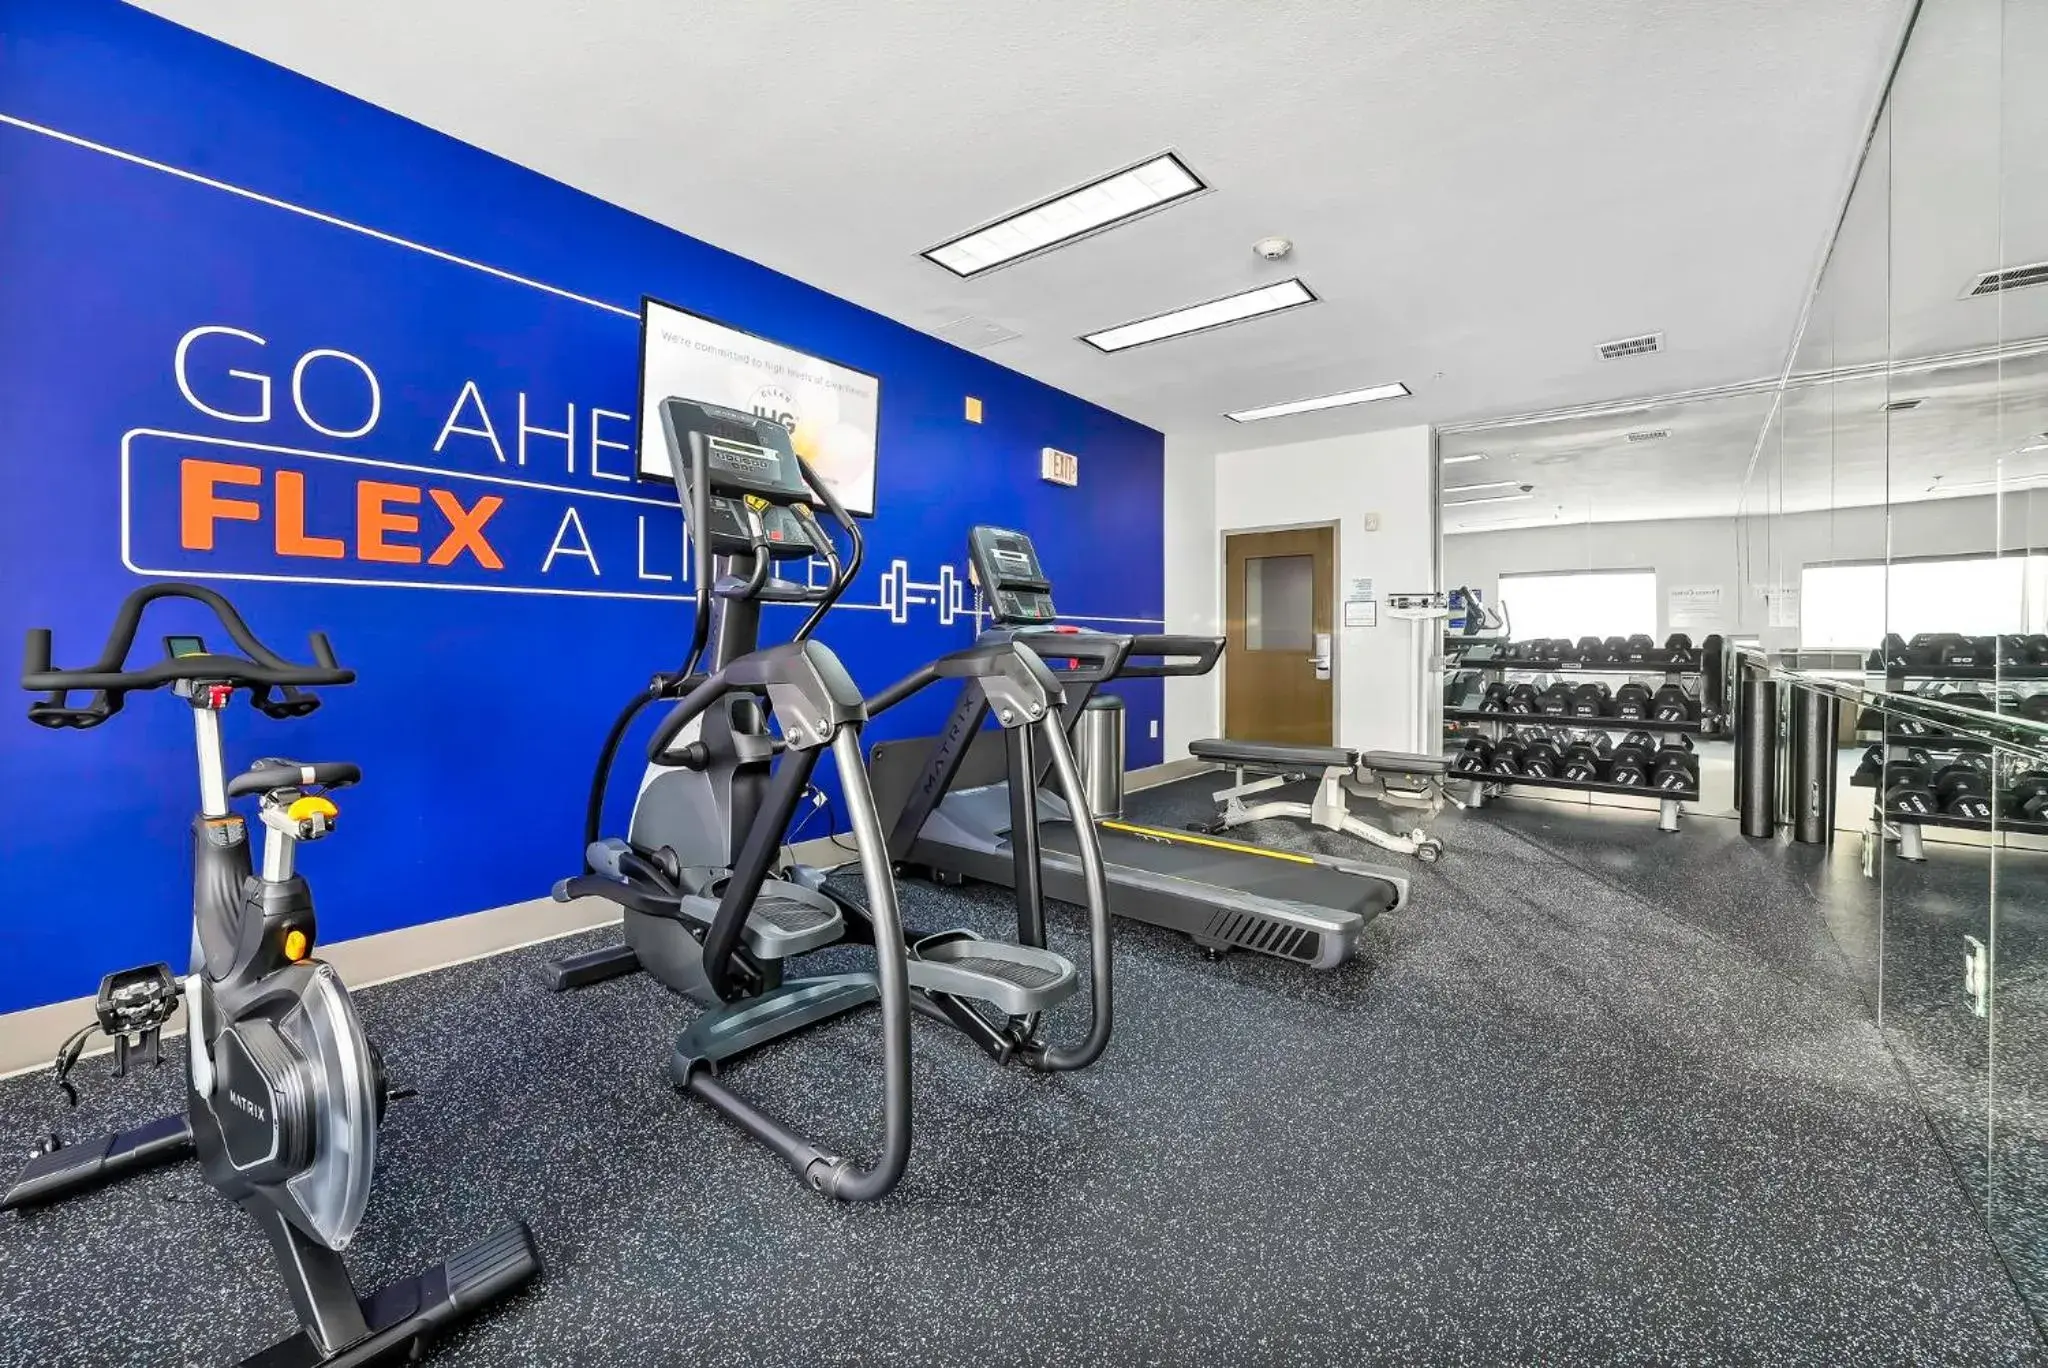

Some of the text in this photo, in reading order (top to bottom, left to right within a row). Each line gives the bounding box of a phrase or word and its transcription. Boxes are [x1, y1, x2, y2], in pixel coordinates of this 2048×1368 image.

[694, 341, 750, 364] committed
[174, 325, 641, 484] GO AHE
[1053, 451, 1073, 482] EXIT
[181, 459, 504, 569] FLEX
[541, 507, 600, 576] A
[923, 696, 975, 794] MATRIX
[229, 1089, 265, 1123] MATRIX
